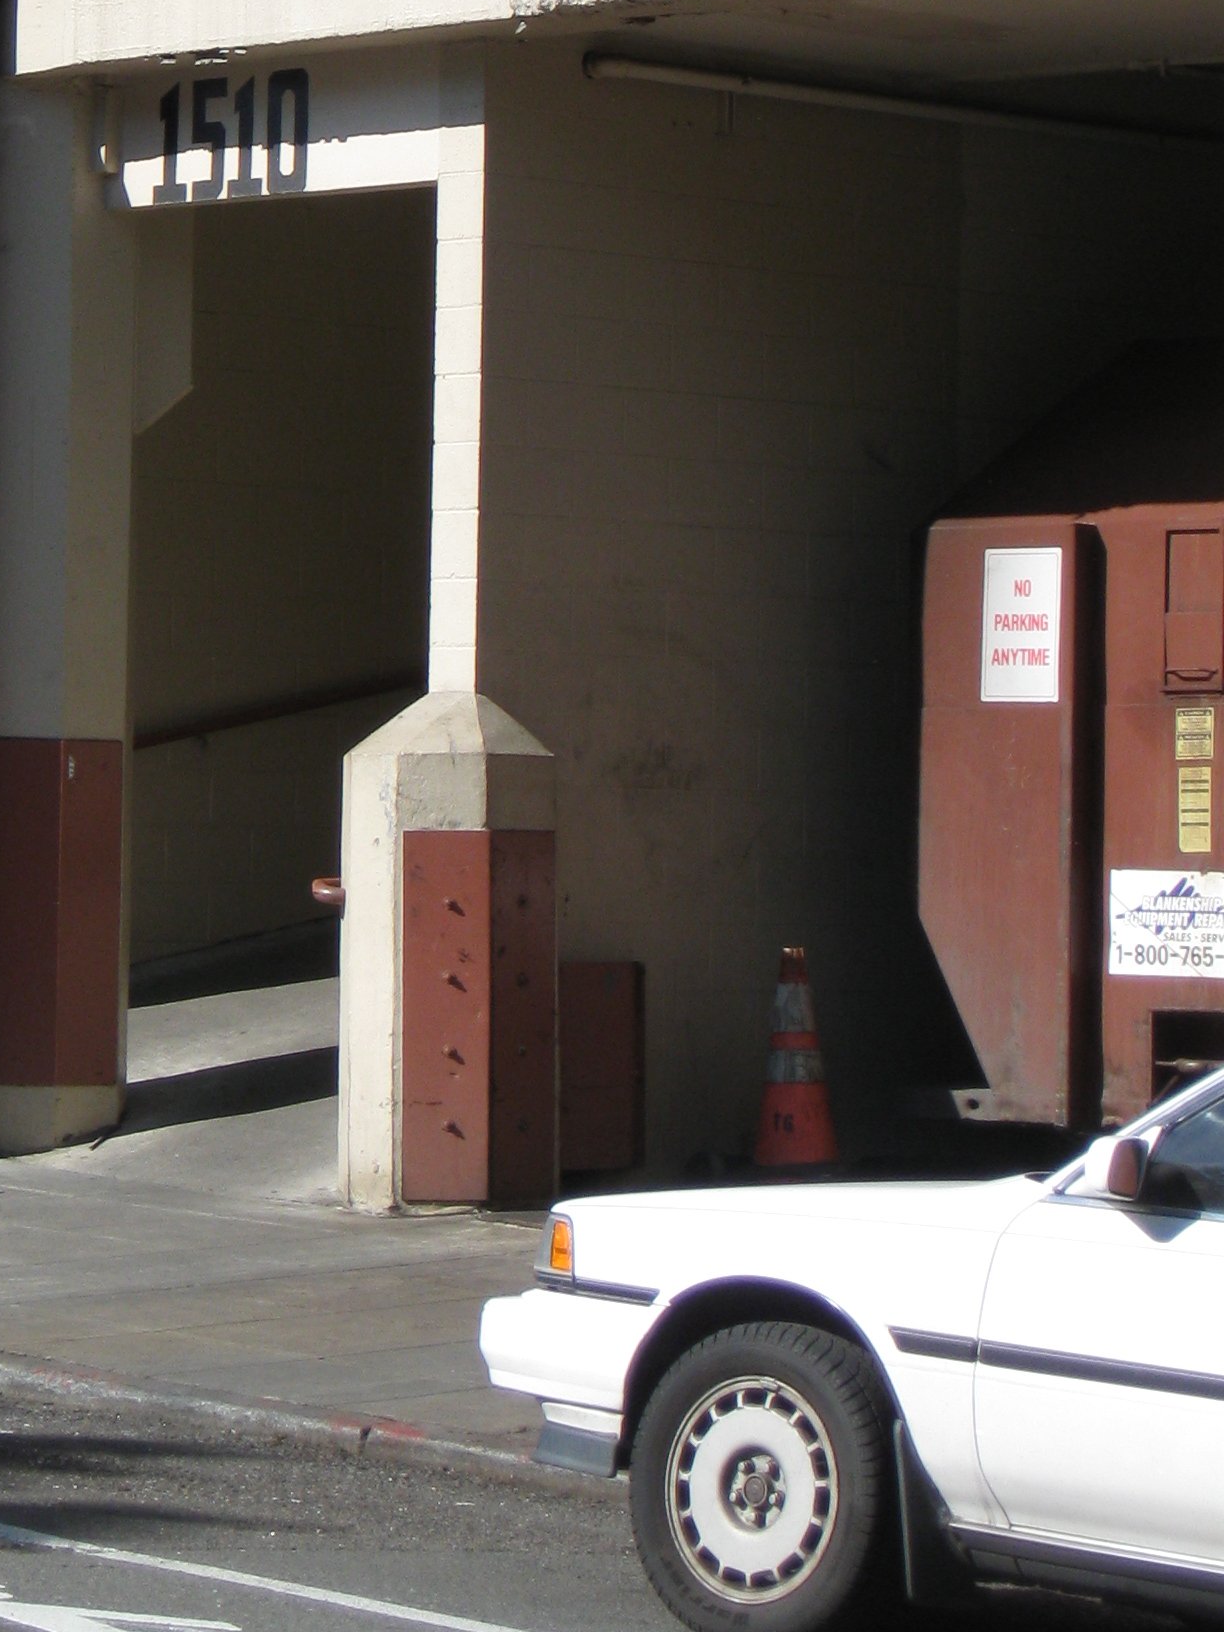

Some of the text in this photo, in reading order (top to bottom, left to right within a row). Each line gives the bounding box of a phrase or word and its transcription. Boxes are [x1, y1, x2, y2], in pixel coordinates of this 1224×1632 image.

[153, 68, 309, 206] 1510
[1014, 579, 1032, 597] NO
[994, 613, 1049, 632] PARKING
[991, 648, 1051, 666] ANYTIME
[1125, 911, 1189, 929] EQUIPMENT
[1164, 932, 1192, 942] SALES
